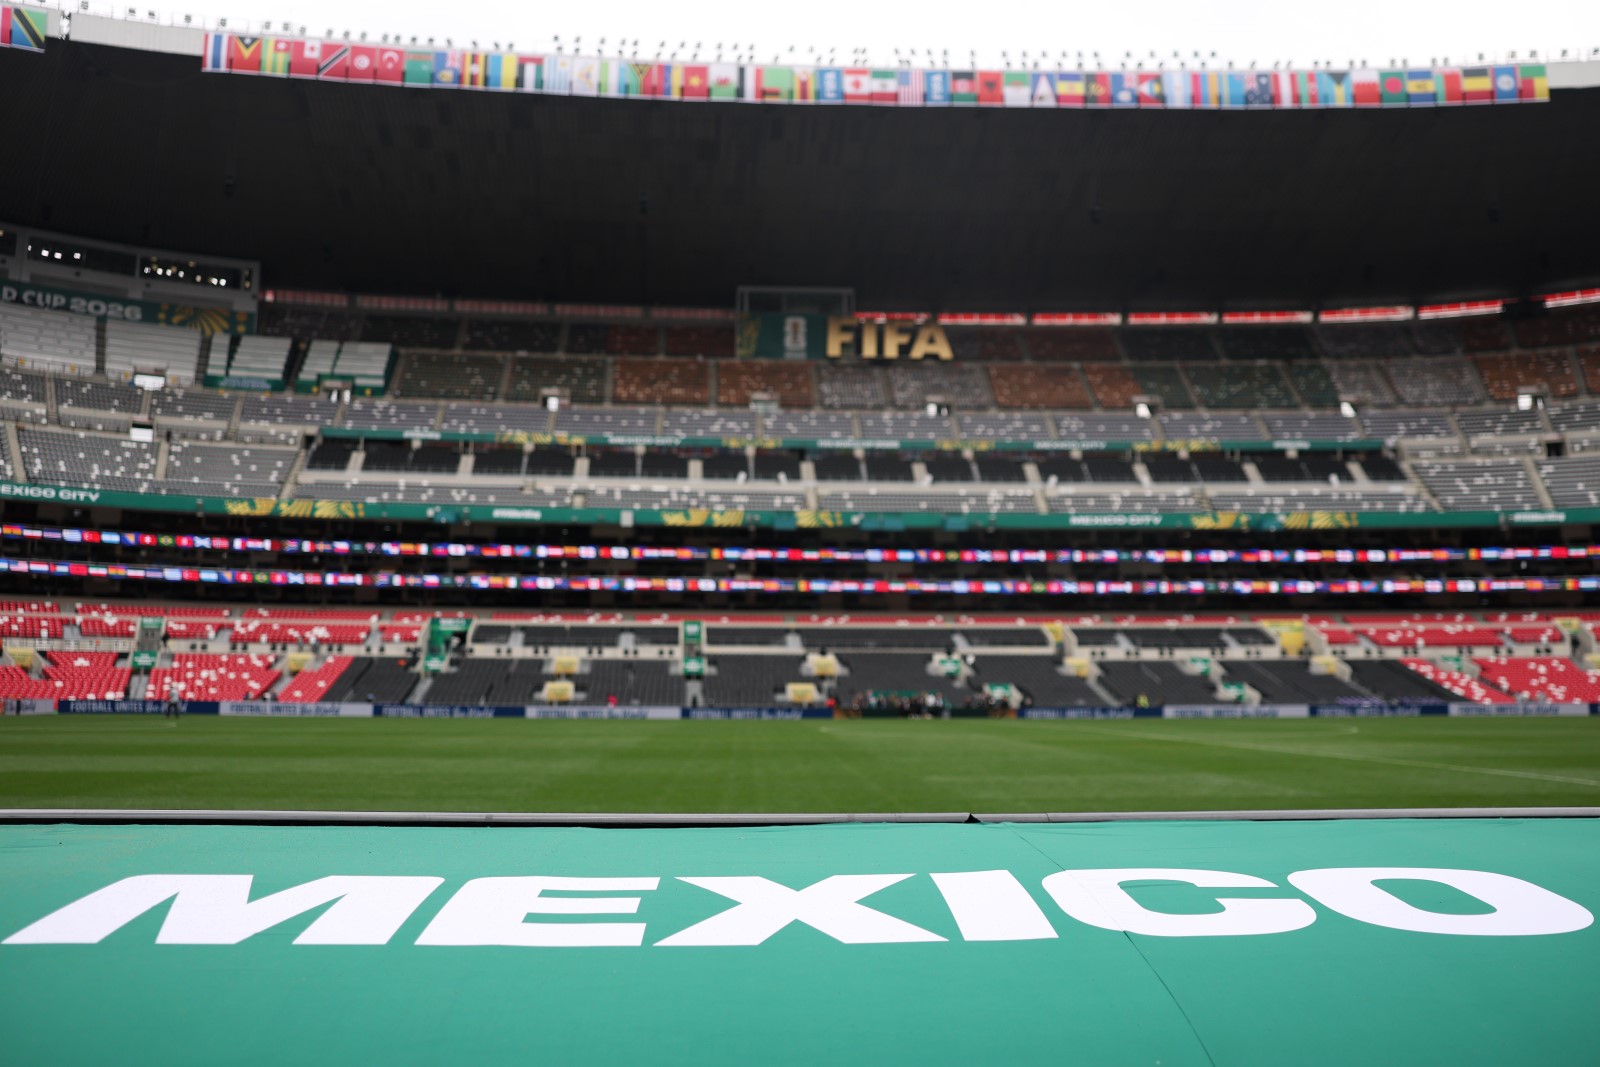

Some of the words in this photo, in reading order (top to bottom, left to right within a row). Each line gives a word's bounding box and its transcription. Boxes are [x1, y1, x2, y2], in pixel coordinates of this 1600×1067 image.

[22, 289, 67, 308] CUP
[70, 297, 142, 321] 2026
[826, 317, 954, 360] FIFA
[58, 488, 100, 502] CITY
[1069, 514, 1128, 526] MEXICO
[1128, 514, 1163, 526] CITY
[70, 702, 112, 713] FOOTBALL
[115, 702, 143, 713] UNITES
[230, 702, 267, 713] FOOTBALL
[271, 702, 297, 713] UNITES
[1, 867, 1594, 946] MEXICO
